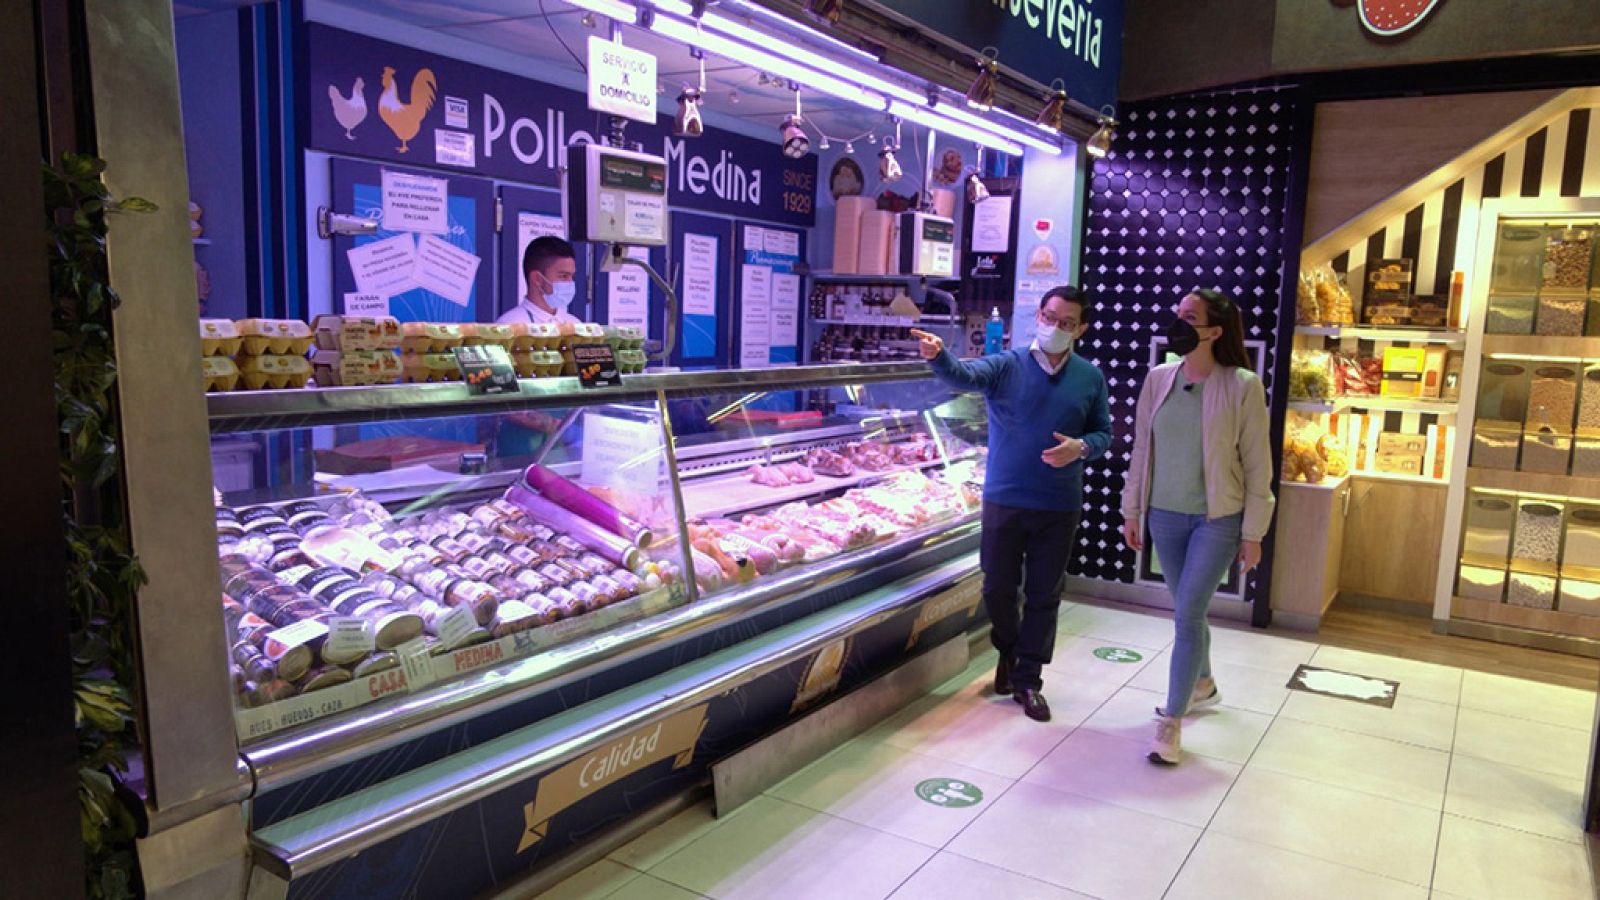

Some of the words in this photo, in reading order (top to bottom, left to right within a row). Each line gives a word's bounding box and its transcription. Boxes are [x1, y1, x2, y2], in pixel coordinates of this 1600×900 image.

[602, 52, 648, 74] SERVICIO
[622, 71, 630, 86] A
[599, 83, 651, 107] DOMICILIO
[663, 136, 762, 206] Medina
[783, 170, 812, 190] SINCE
[783, 191, 812, 214] 1929
[454, 642, 504, 672] MEDINA
[368, 671, 409, 699] CASA
[321, 699, 343, 714] CAZA
[579, 722, 662, 788] Calidad
